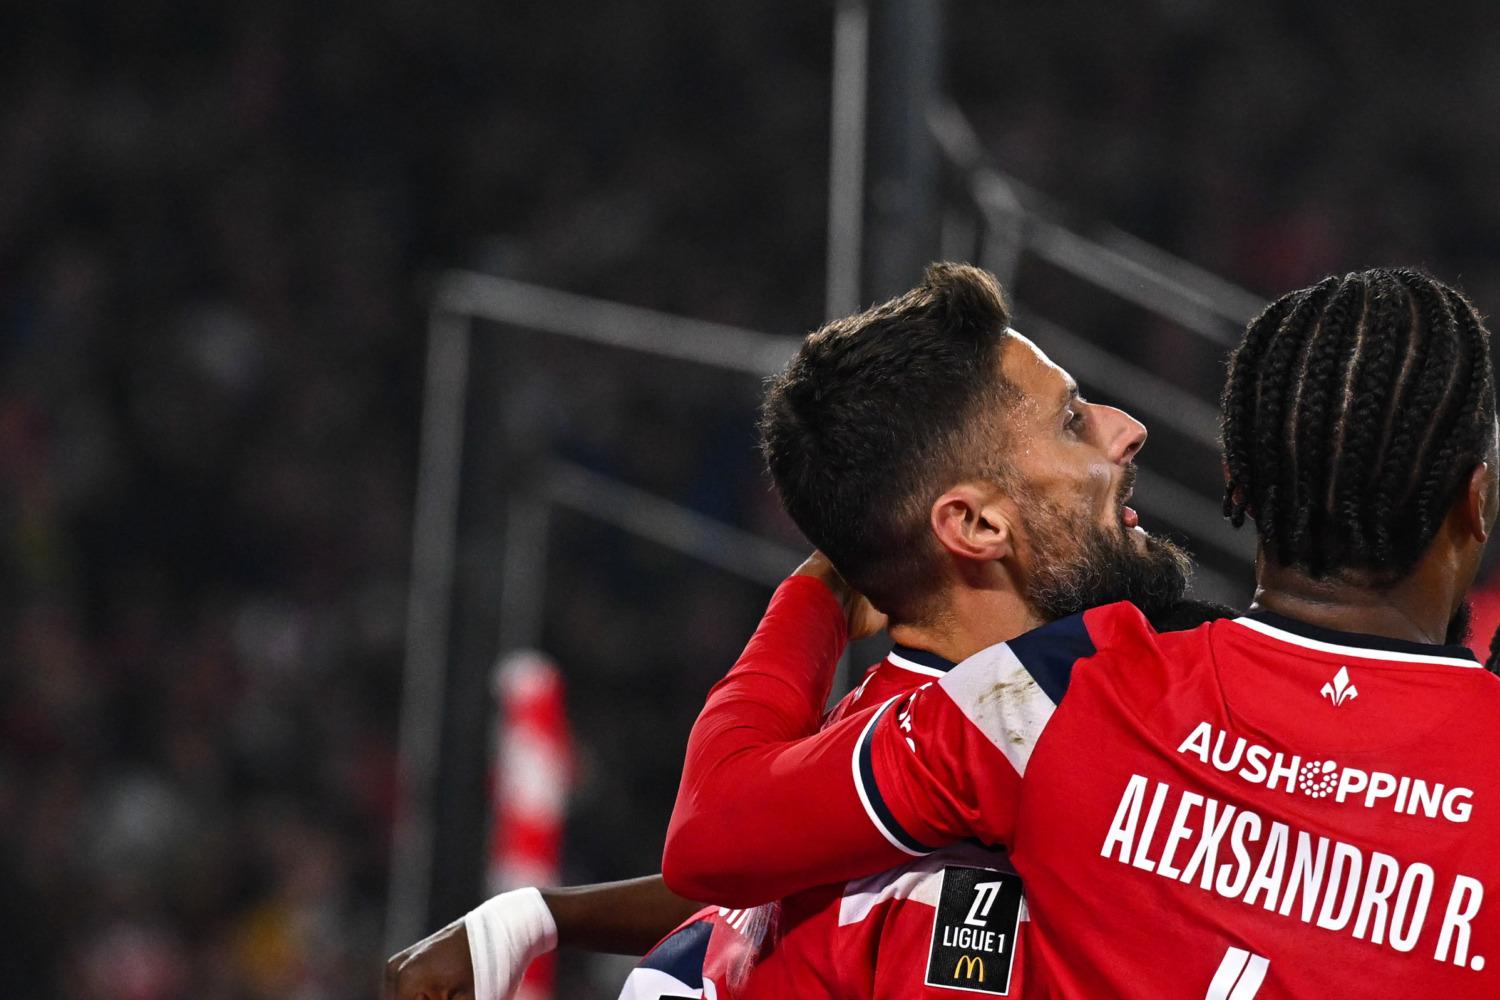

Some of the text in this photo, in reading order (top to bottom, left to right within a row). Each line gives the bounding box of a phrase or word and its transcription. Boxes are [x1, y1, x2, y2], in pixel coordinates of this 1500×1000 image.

[1177, 721, 1474, 823] AUSHOPPING
[1100, 774, 1485, 971] ALEXSANDRO R.
[943, 926, 1006, 953] LIGUE 1
